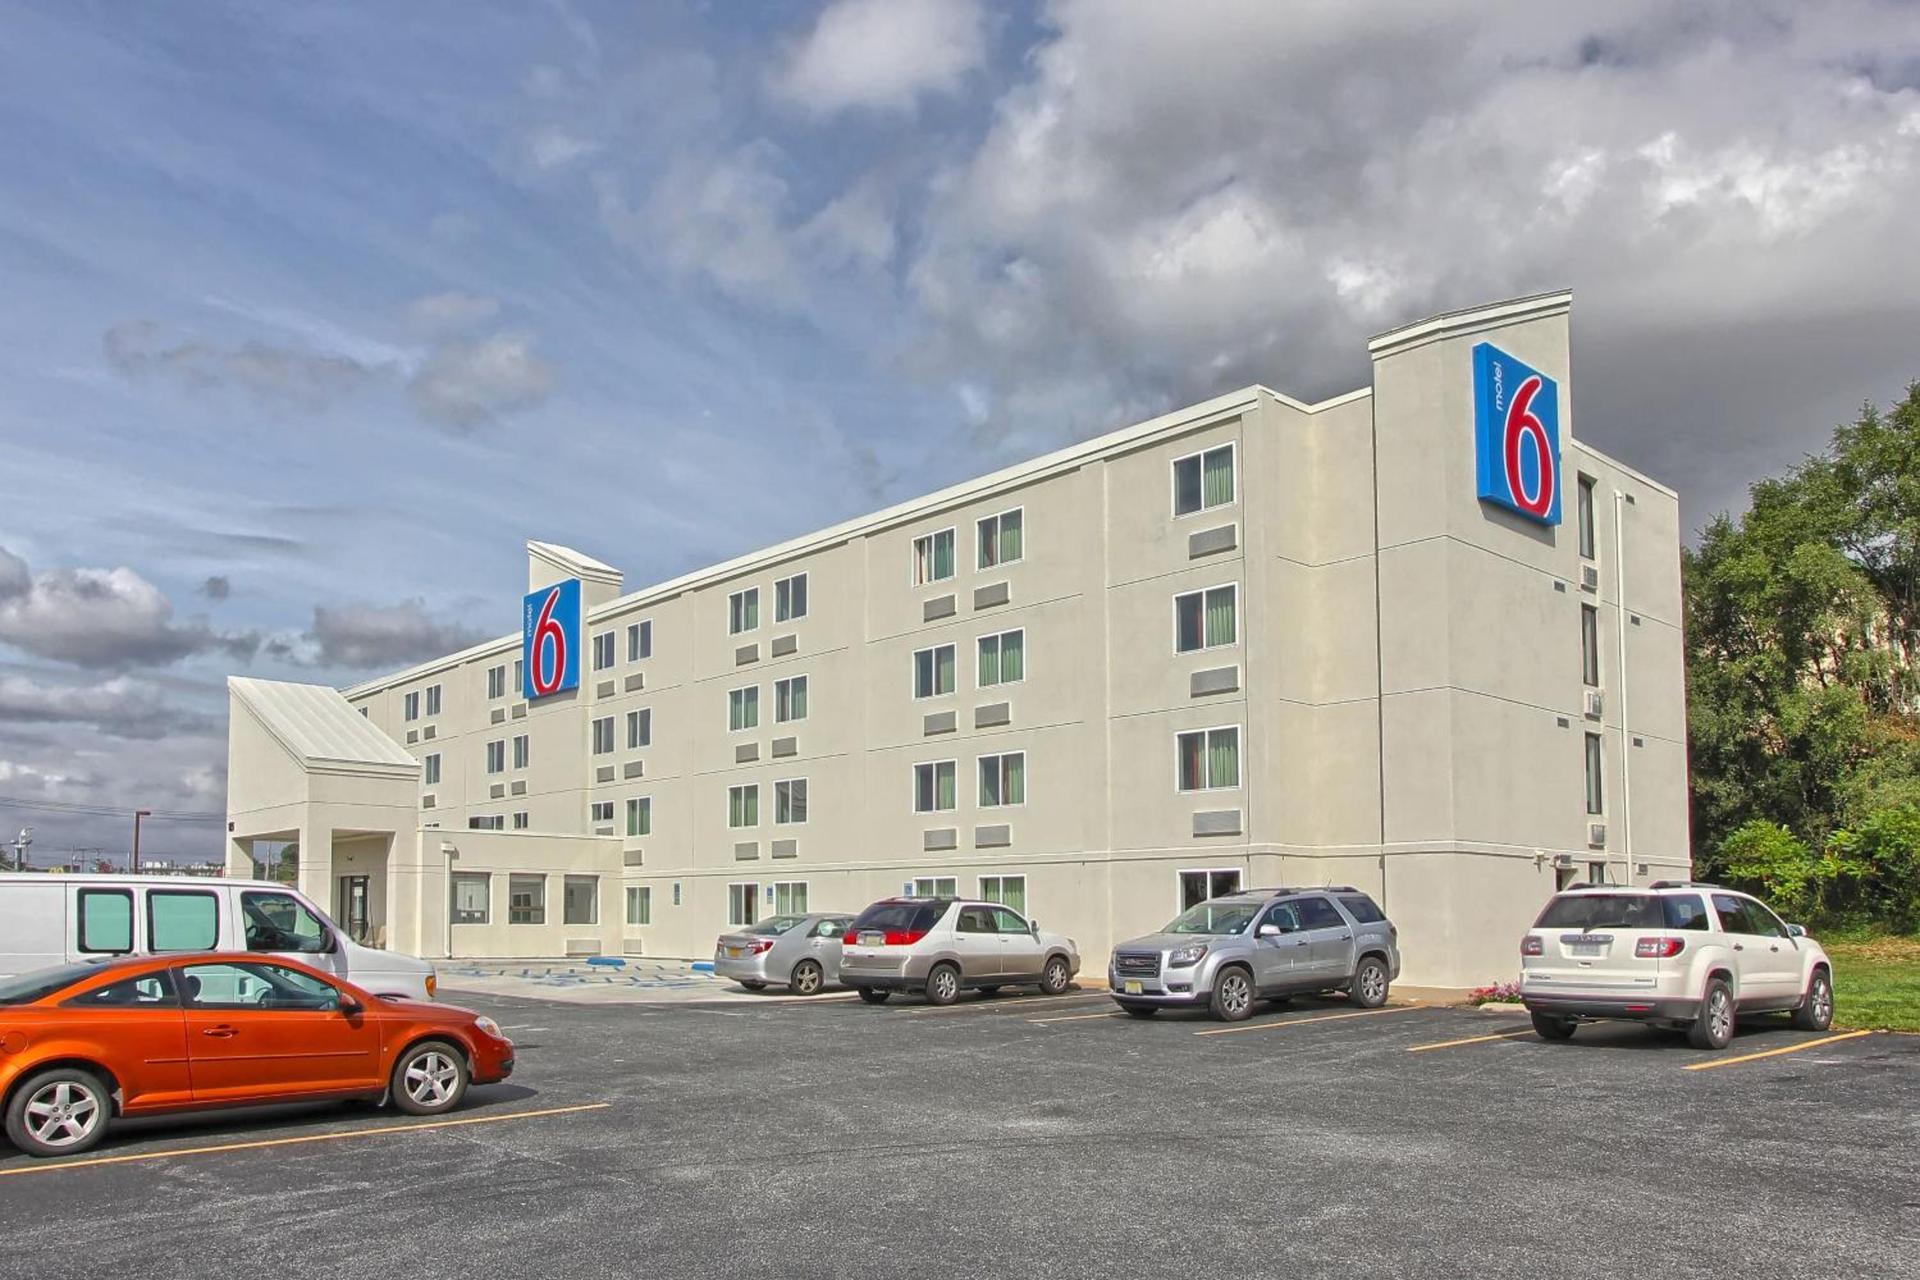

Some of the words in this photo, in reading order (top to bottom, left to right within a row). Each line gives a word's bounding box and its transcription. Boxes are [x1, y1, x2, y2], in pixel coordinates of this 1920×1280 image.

[1493, 361, 1504, 411] motel
[1503, 375, 1554, 518] 6
[531, 587, 566, 696] 6
